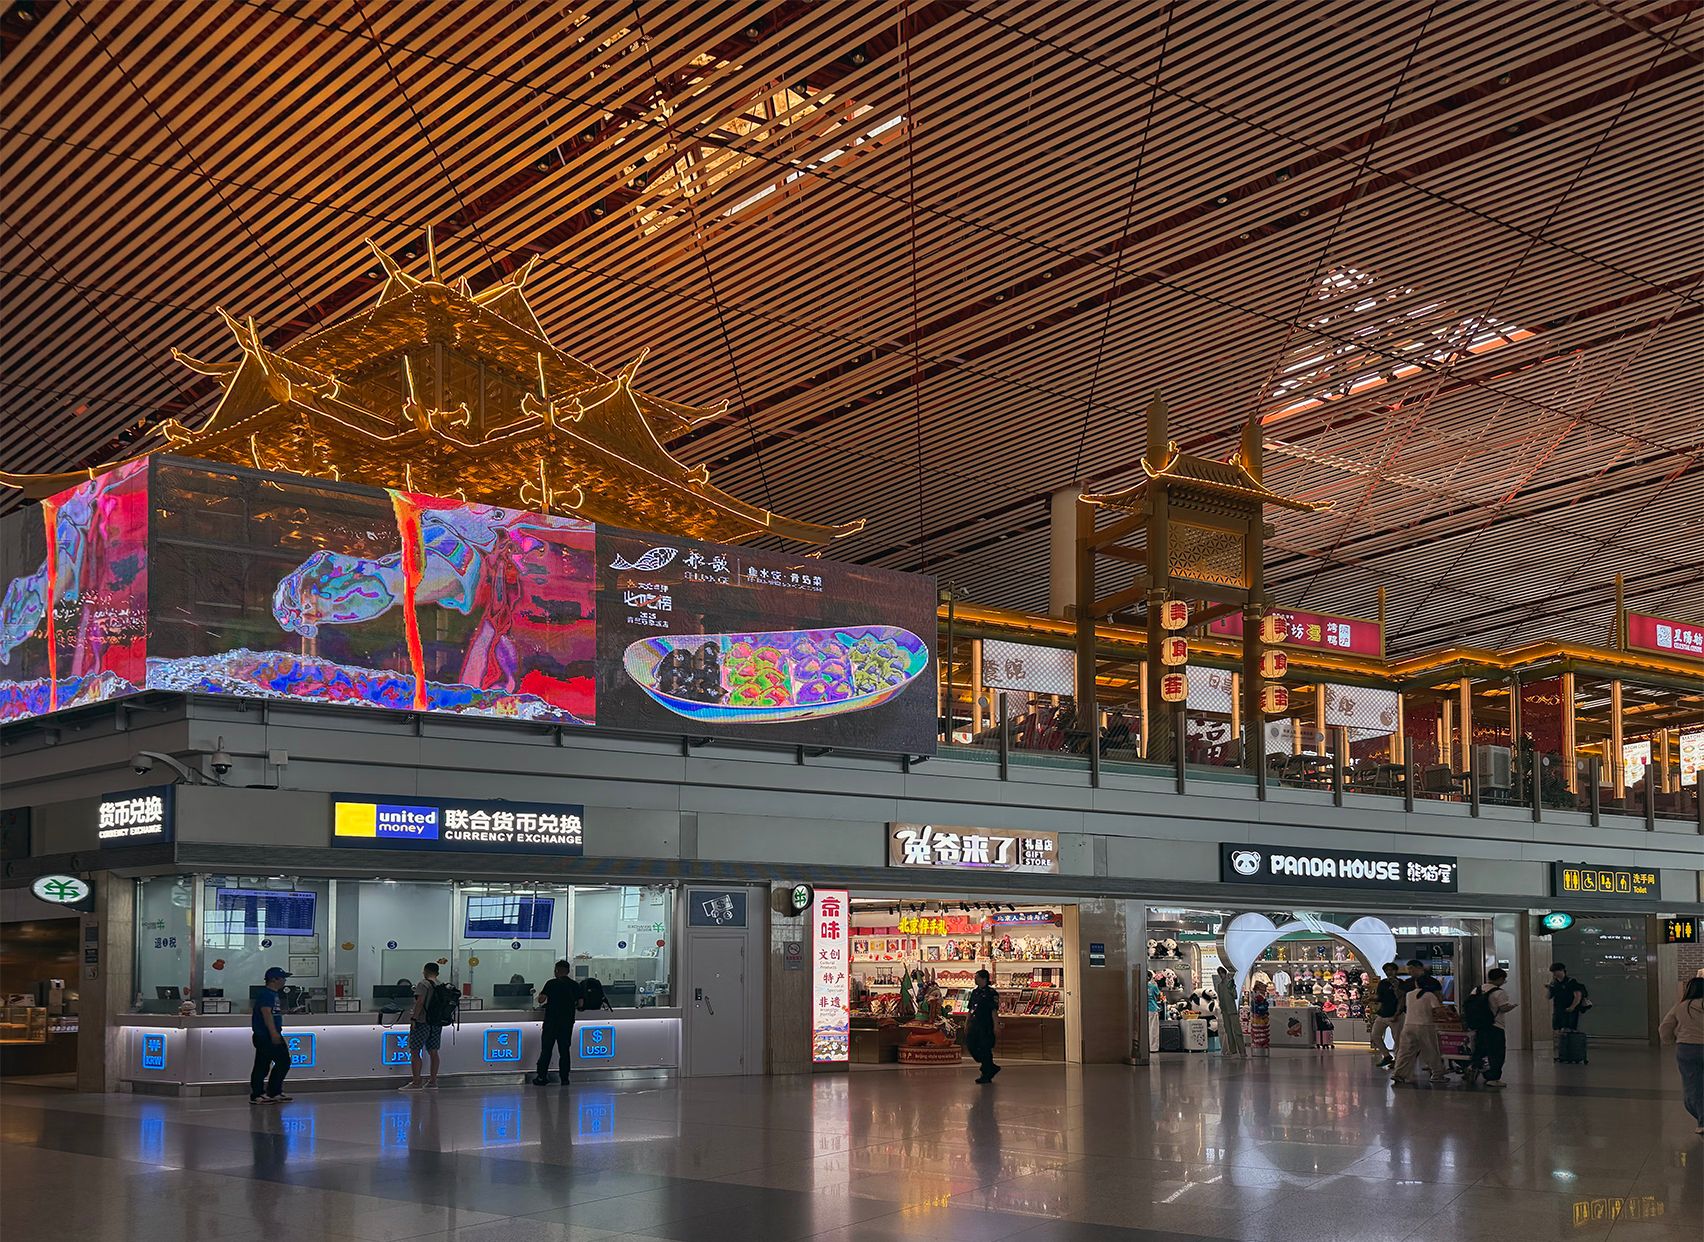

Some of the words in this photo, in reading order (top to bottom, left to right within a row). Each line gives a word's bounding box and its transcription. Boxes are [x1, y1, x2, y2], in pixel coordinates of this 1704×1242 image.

[98, 795, 163, 829] 货币兑换
[379, 810, 436, 824] united
[445, 809, 582, 834] 联合货币兑换
[98, 828, 130, 839] CURRENCY
[130, 823, 163, 836] EXCHANGE
[378, 823, 425, 834] money
[445, 830, 514, 843] CURRENCY
[516, 833, 583, 845] EXCHANGE
[895, 825, 1016, 865] 兔爷来了
[1024, 838, 1054, 852] 礼品店
[1024, 851, 1044, 859] GIFT
[1024, 858, 1052, 867] STORE
[1270, 854, 1337, 878] PANDA
[1339, 858, 1400, 881] HOUSE
[1406, 861, 1453, 884] 熊猫屋
[1632, 873, 1656, 885] 洗手间
[821, 896, 841, 940] 京味
[819, 949, 840, 961] 文创
[823, 972, 845, 984] 特产
[819, 996, 841, 1008] 非遗
[491, 1049, 513, 1058] EUR
[586, 1046, 608, 1055] USD
[145, 1055, 163, 1066] KRW
[290, 1054, 307, 1064] BP
[391, 1052, 412, 1062] JPY
